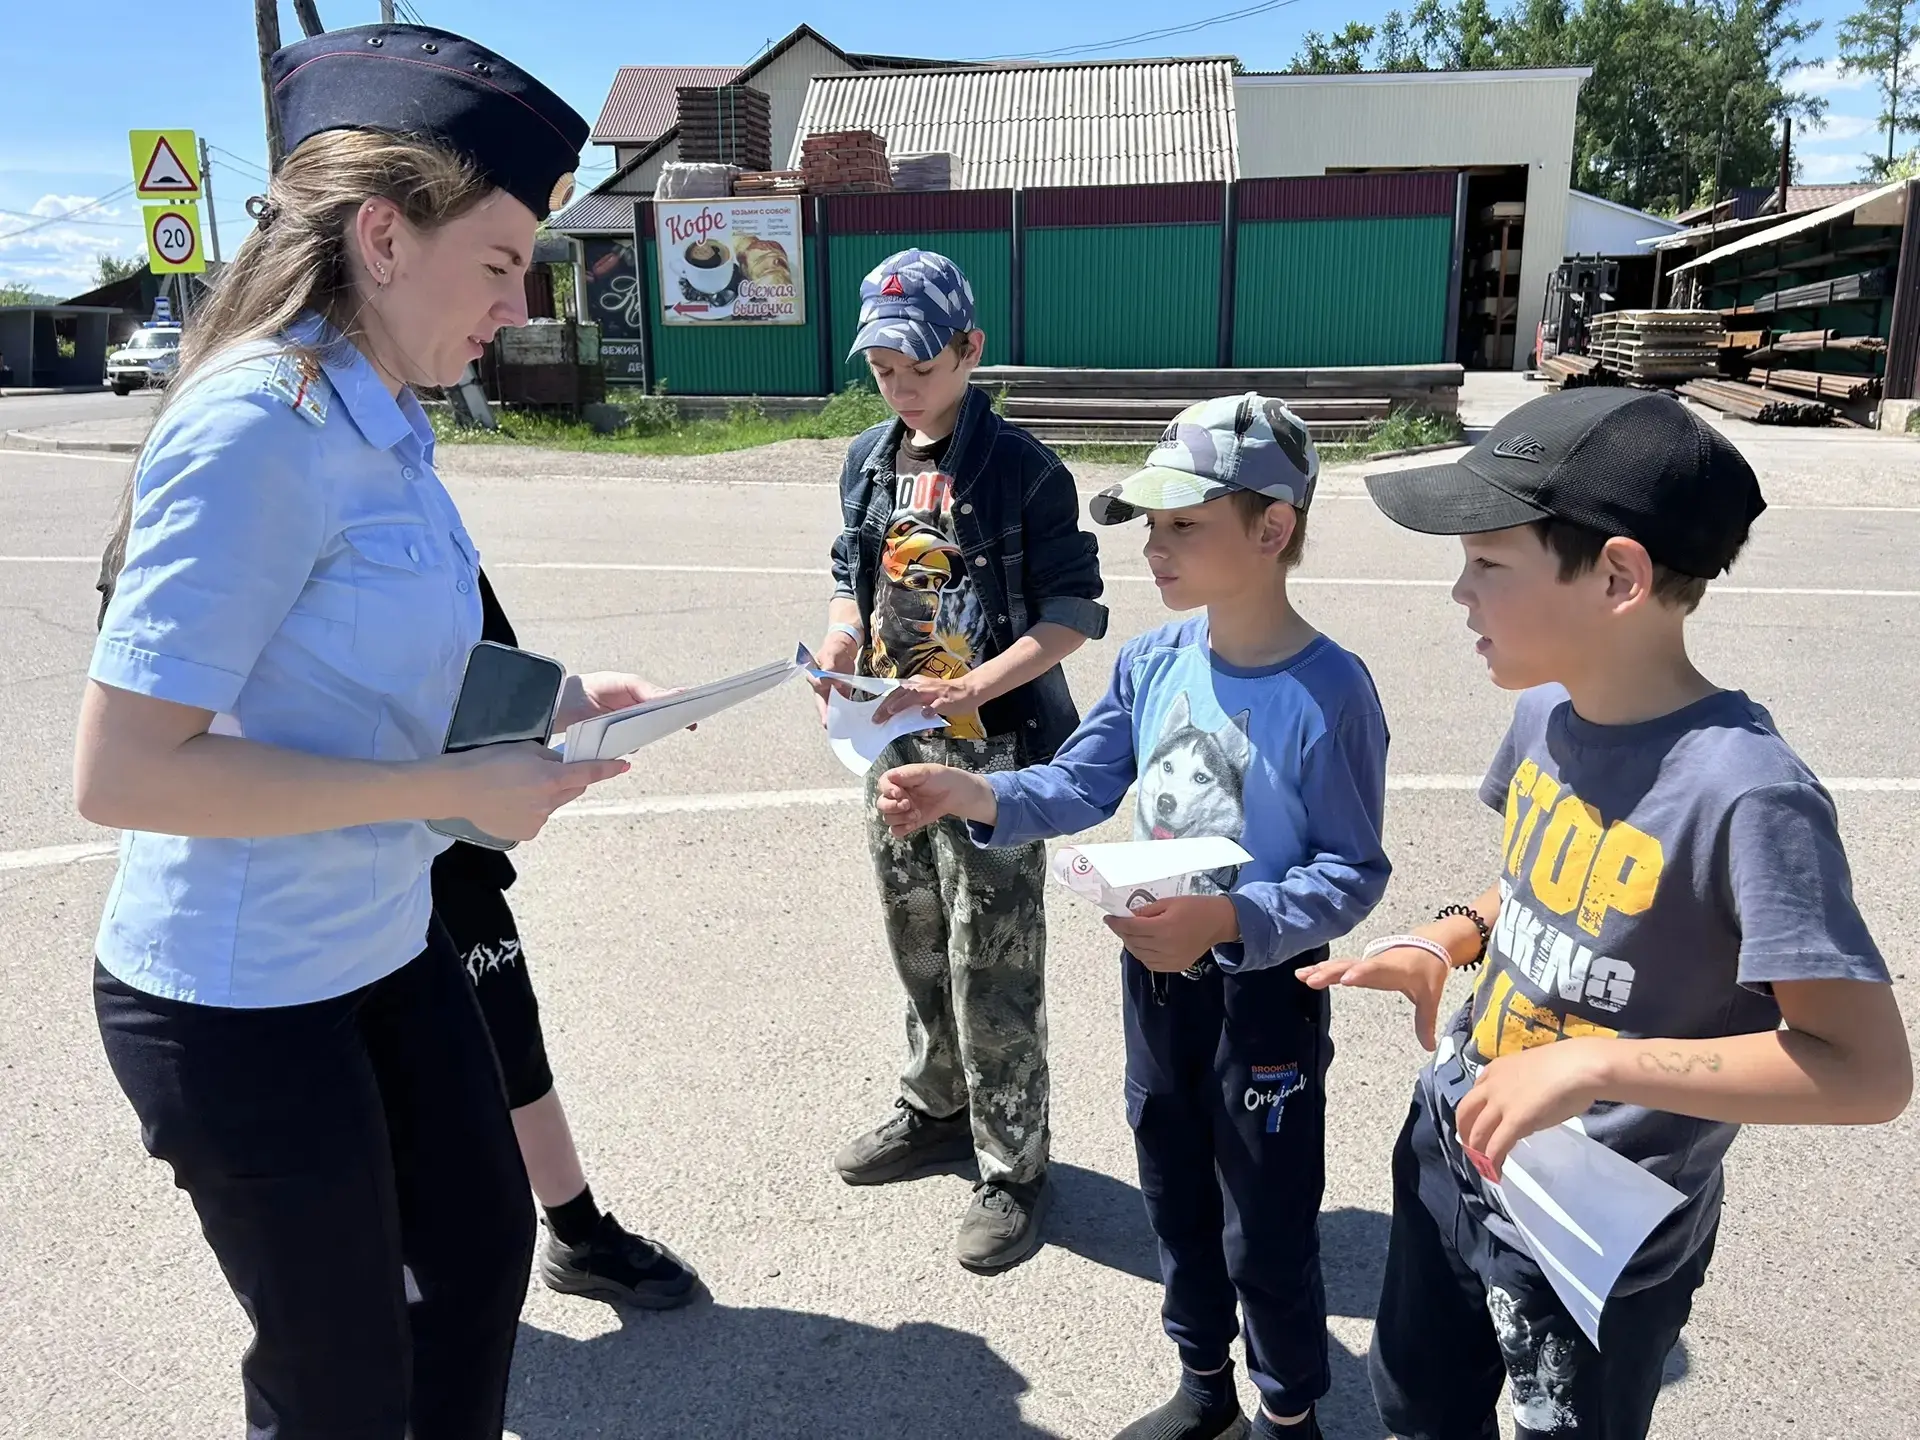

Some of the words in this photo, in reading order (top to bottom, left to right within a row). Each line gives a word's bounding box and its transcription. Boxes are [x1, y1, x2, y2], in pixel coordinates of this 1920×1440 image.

[665, 206, 727, 246] Кофе
[162, 228, 186, 249] 20
[738, 281, 795, 298] Свежая
[732, 302, 794, 316] выпечка
[600, 344, 639, 356] ВЕЖИЙ
[627, 362, 644, 373] ДЕ
[1251, 1061, 1298, 1074] BROOKLYN
[1244, 1073, 1307, 1111] Original
